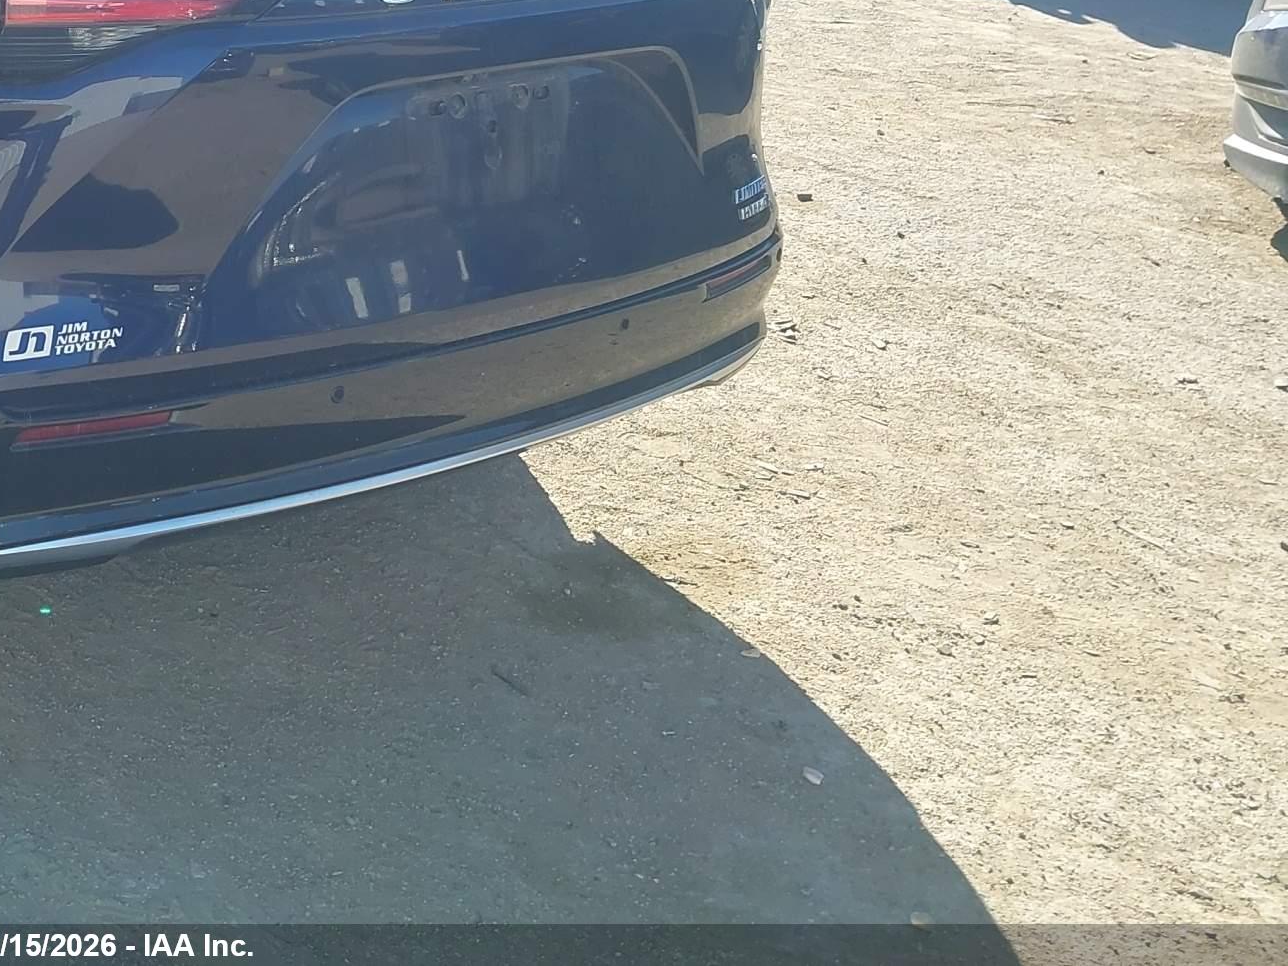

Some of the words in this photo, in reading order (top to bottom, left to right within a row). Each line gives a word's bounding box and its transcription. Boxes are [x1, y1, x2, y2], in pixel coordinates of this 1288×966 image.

[55, 327, 124, 346] NORTON
[57, 321, 88, 335] JIM
[54, 338, 117, 356] TOYOTA
